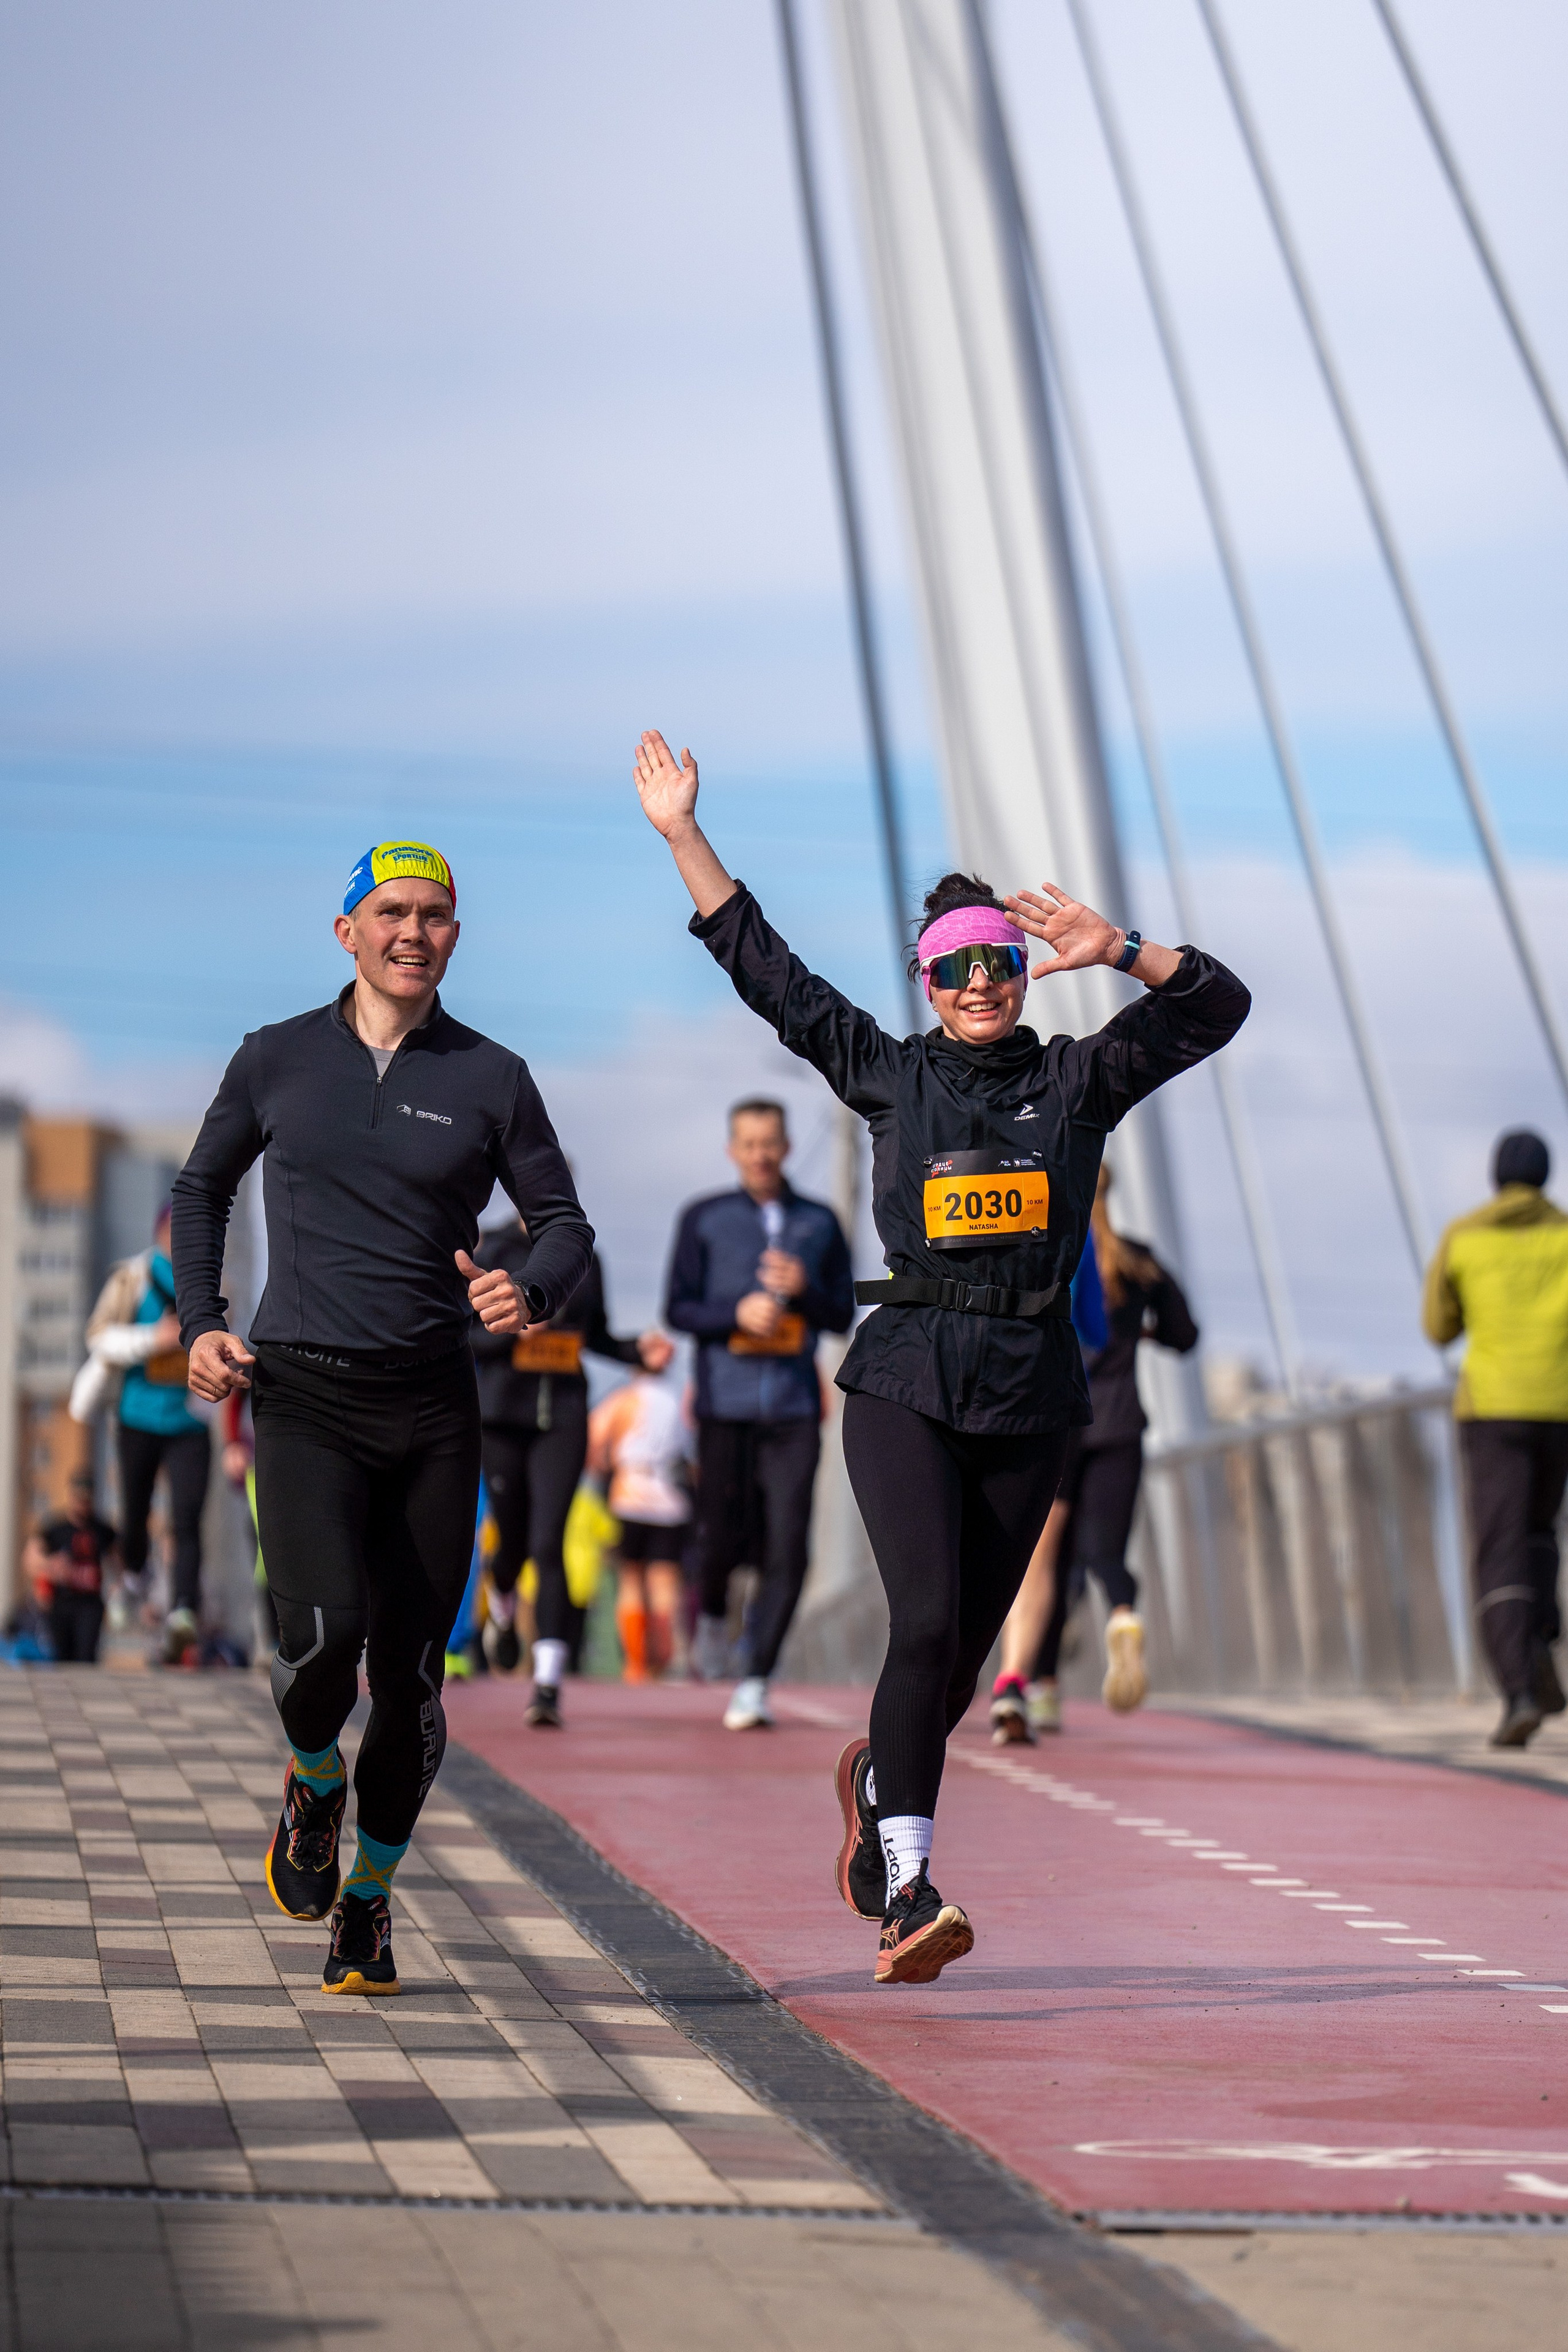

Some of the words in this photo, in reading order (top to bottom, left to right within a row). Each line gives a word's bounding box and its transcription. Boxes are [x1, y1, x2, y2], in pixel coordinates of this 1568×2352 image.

[382, 846, 434, 860] Panasonic
[417, 1110, 452, 1125] BRIKO
[944, 1189, 1022, 1221] 2030
